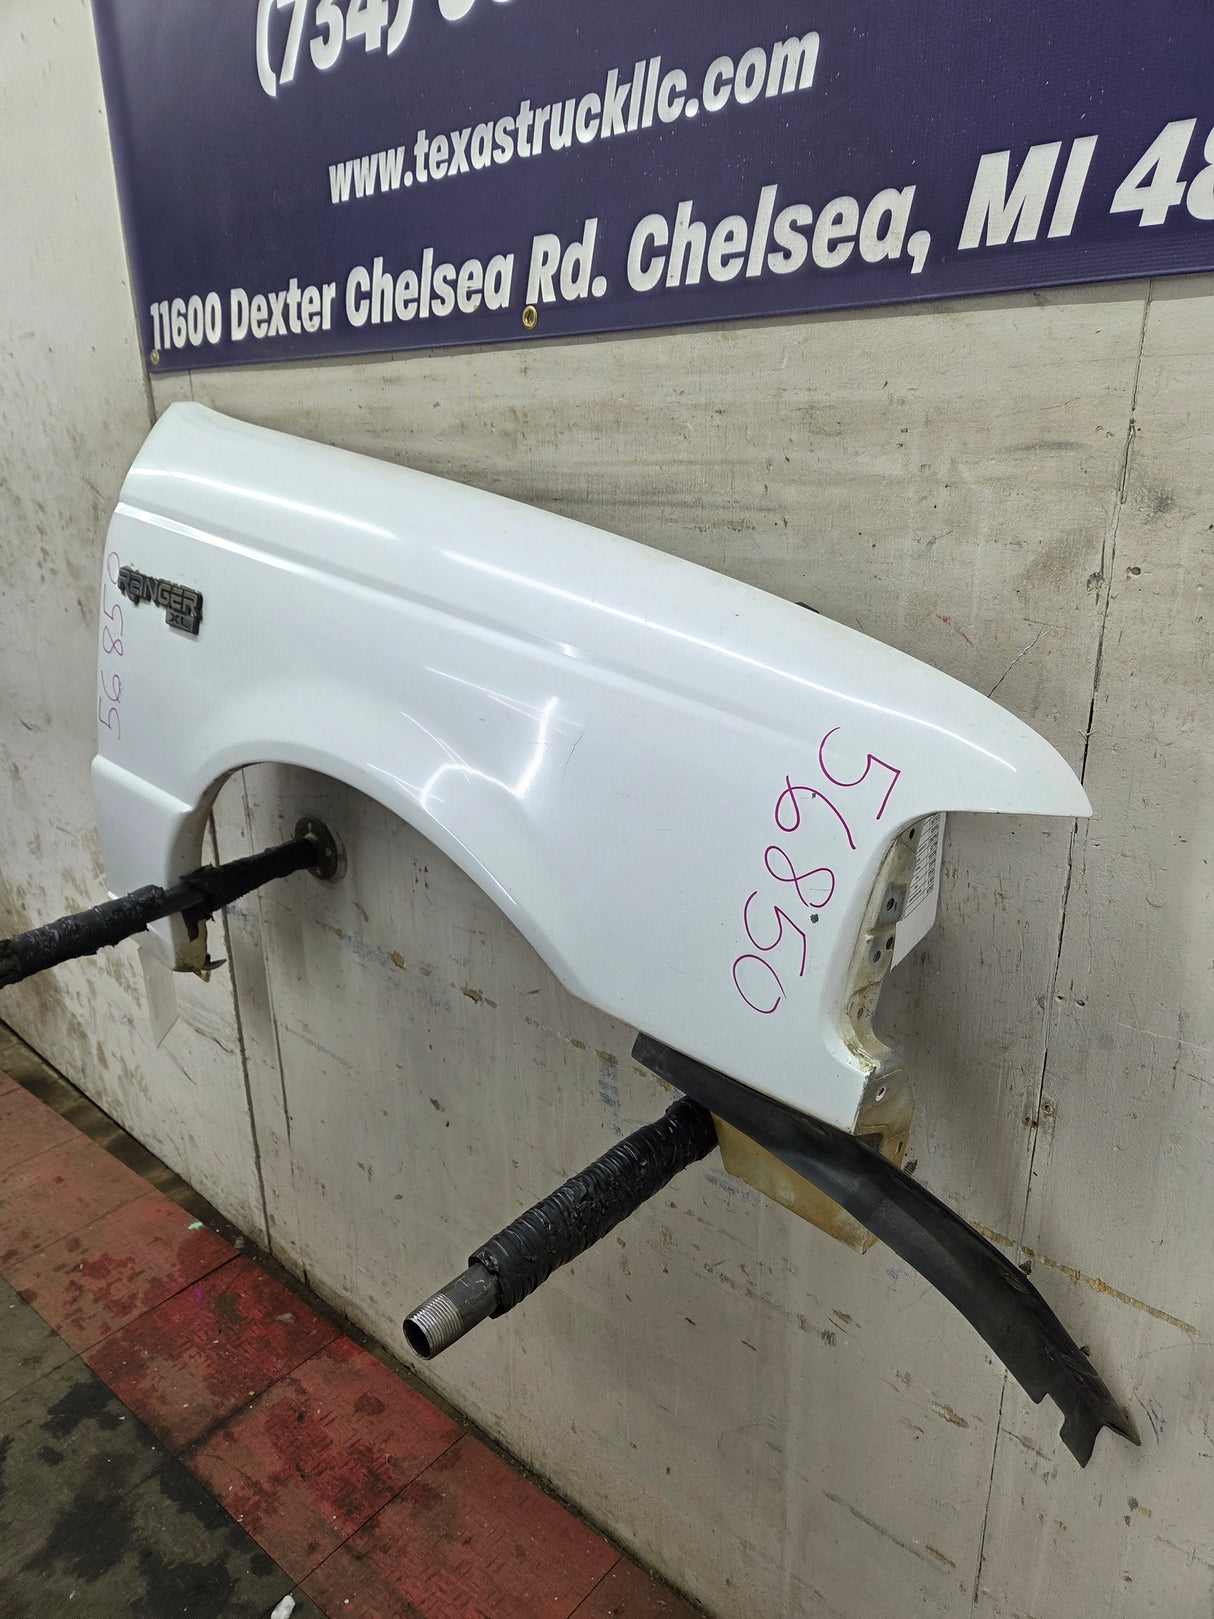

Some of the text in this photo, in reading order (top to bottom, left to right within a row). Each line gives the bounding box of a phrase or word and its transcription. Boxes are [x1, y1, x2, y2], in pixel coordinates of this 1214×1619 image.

[255, 0, 415, 97] (734)
[328, 32, 820, 204] www.texastruckllc.com
[150, 291, 222, 350] 11600
[230, 278, 336, 341] Dexter
[346, 247, 515, 327] Chelsea
[525, 218, 608, 305] Rd.
[627, 184, 931, 292] Chelsea,
[957, 134, 1099, 251] MI
[118, 567, 202, 617] RANGER
[169, 611, 194, 631] XL
[732, 726, 901, 1014] 56850
